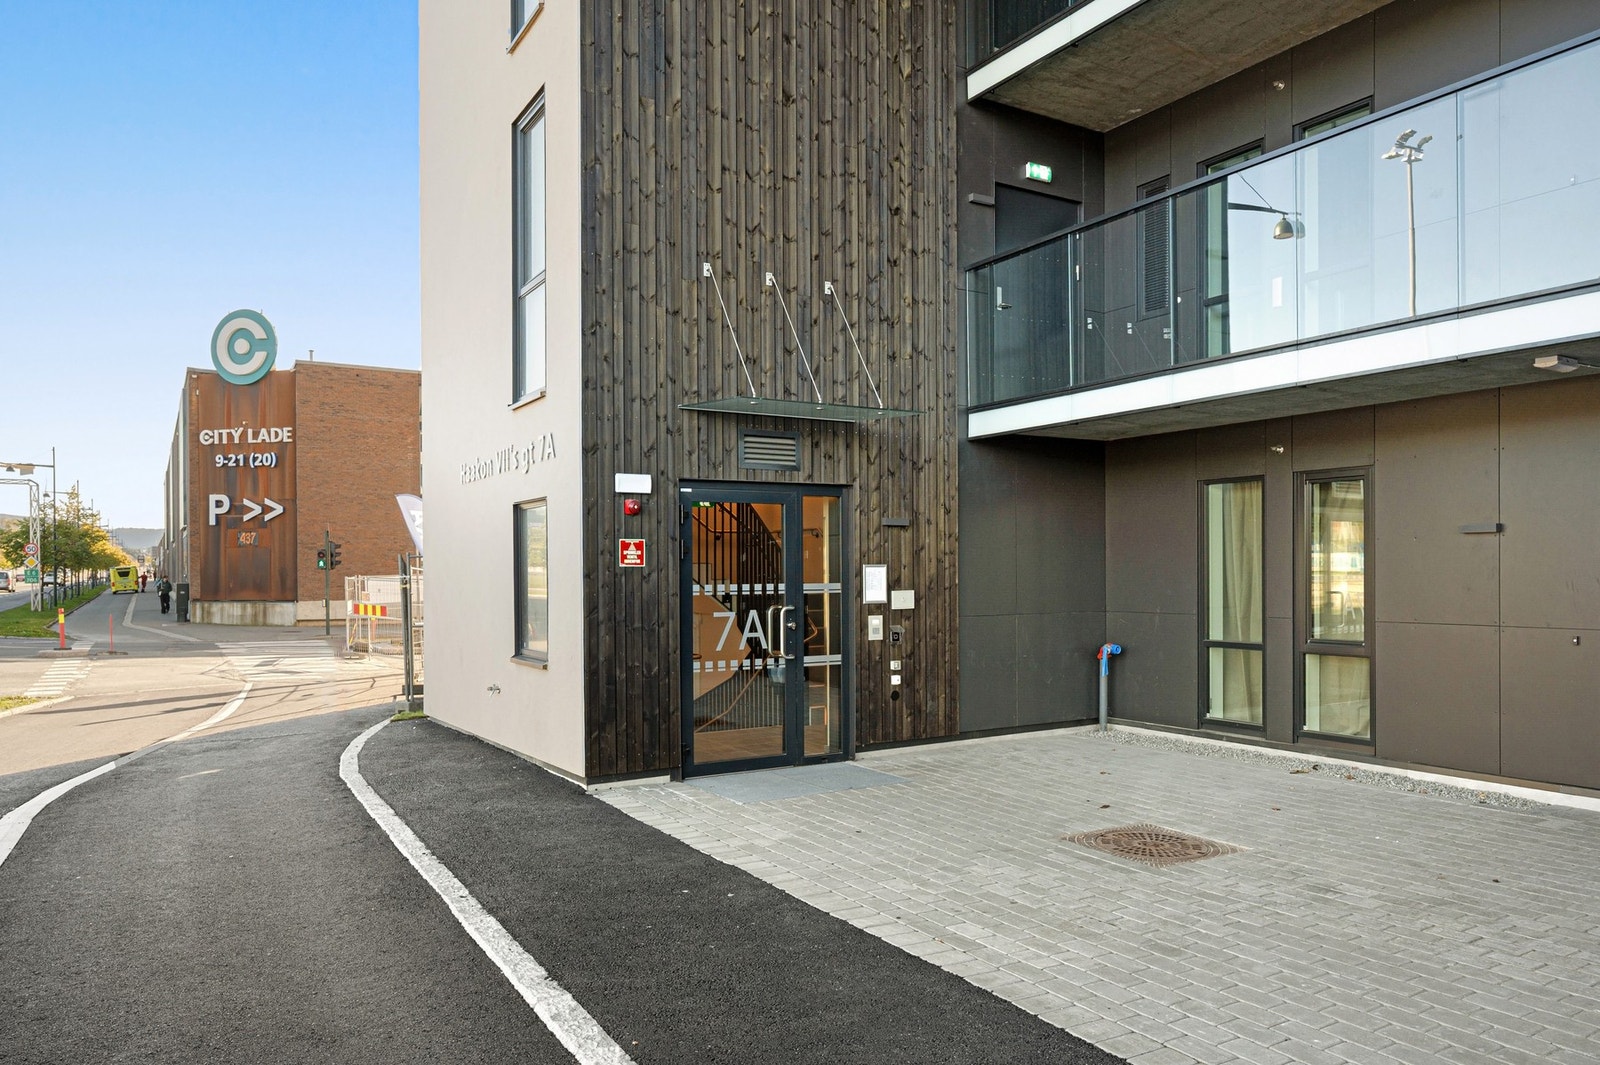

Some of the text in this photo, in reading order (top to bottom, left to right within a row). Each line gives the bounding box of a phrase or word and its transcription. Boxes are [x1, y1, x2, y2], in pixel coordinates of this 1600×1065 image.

[199, 427, 293, 445] CITY LADE
[215, 452, 277, 468] 9-21 (20)
[459, 457, 494, 485] Haakon
[522, 442, 535, 475] gt
[538, 432, 556, 462] 7A
[209, 494, 230, 526] P
[239, 532, 256, 544] 437
[713, 609, 768, 651] 7A
